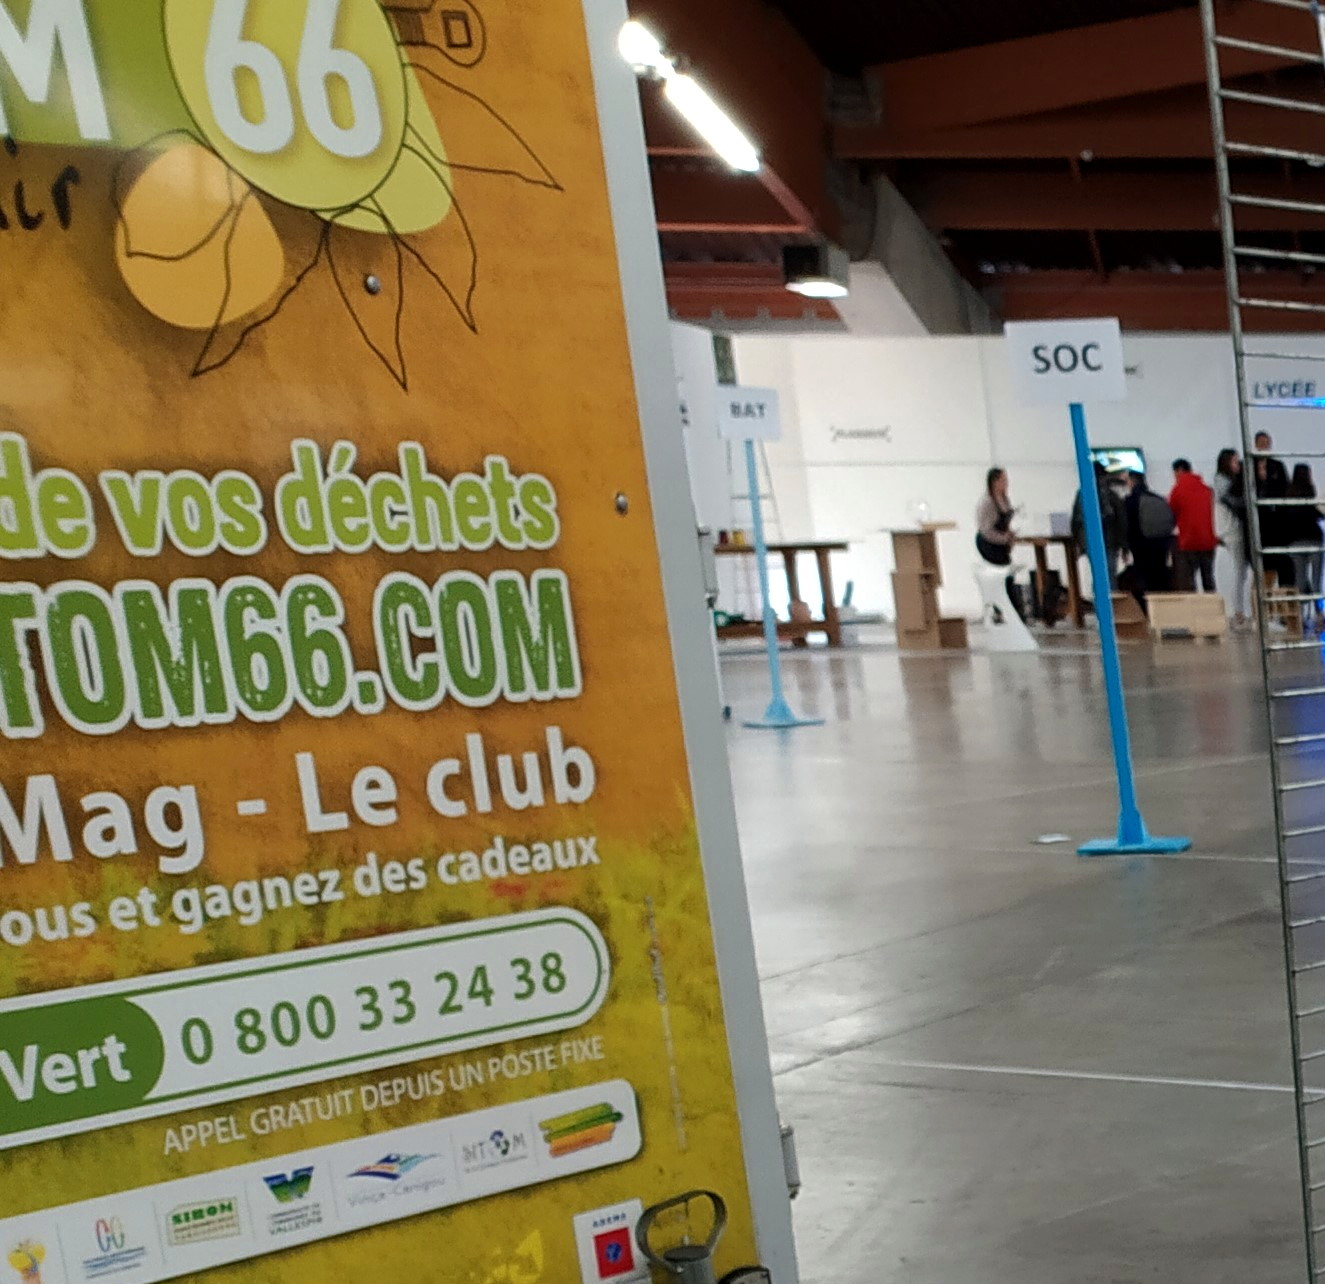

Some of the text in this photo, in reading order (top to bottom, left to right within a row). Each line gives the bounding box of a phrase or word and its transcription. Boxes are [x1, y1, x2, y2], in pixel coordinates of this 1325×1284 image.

[204, 0, 383, 158] 66
[1032, 342, 1104, 374] SOC
[0, 432, 560, 558] de vos déchets
[0, 569, 582, 740] TOM66.COM
[0, 725, 597, 876] Mag - Le club
[1, 834, 601, 947] ous et gagnez des cadeaux
[0, 951, 567, 1101] Vert 0 800 33 24 38
[163, 1035, 606, 1156] APPEL GRATUIT DEPUIS UN POSTE FIXE
